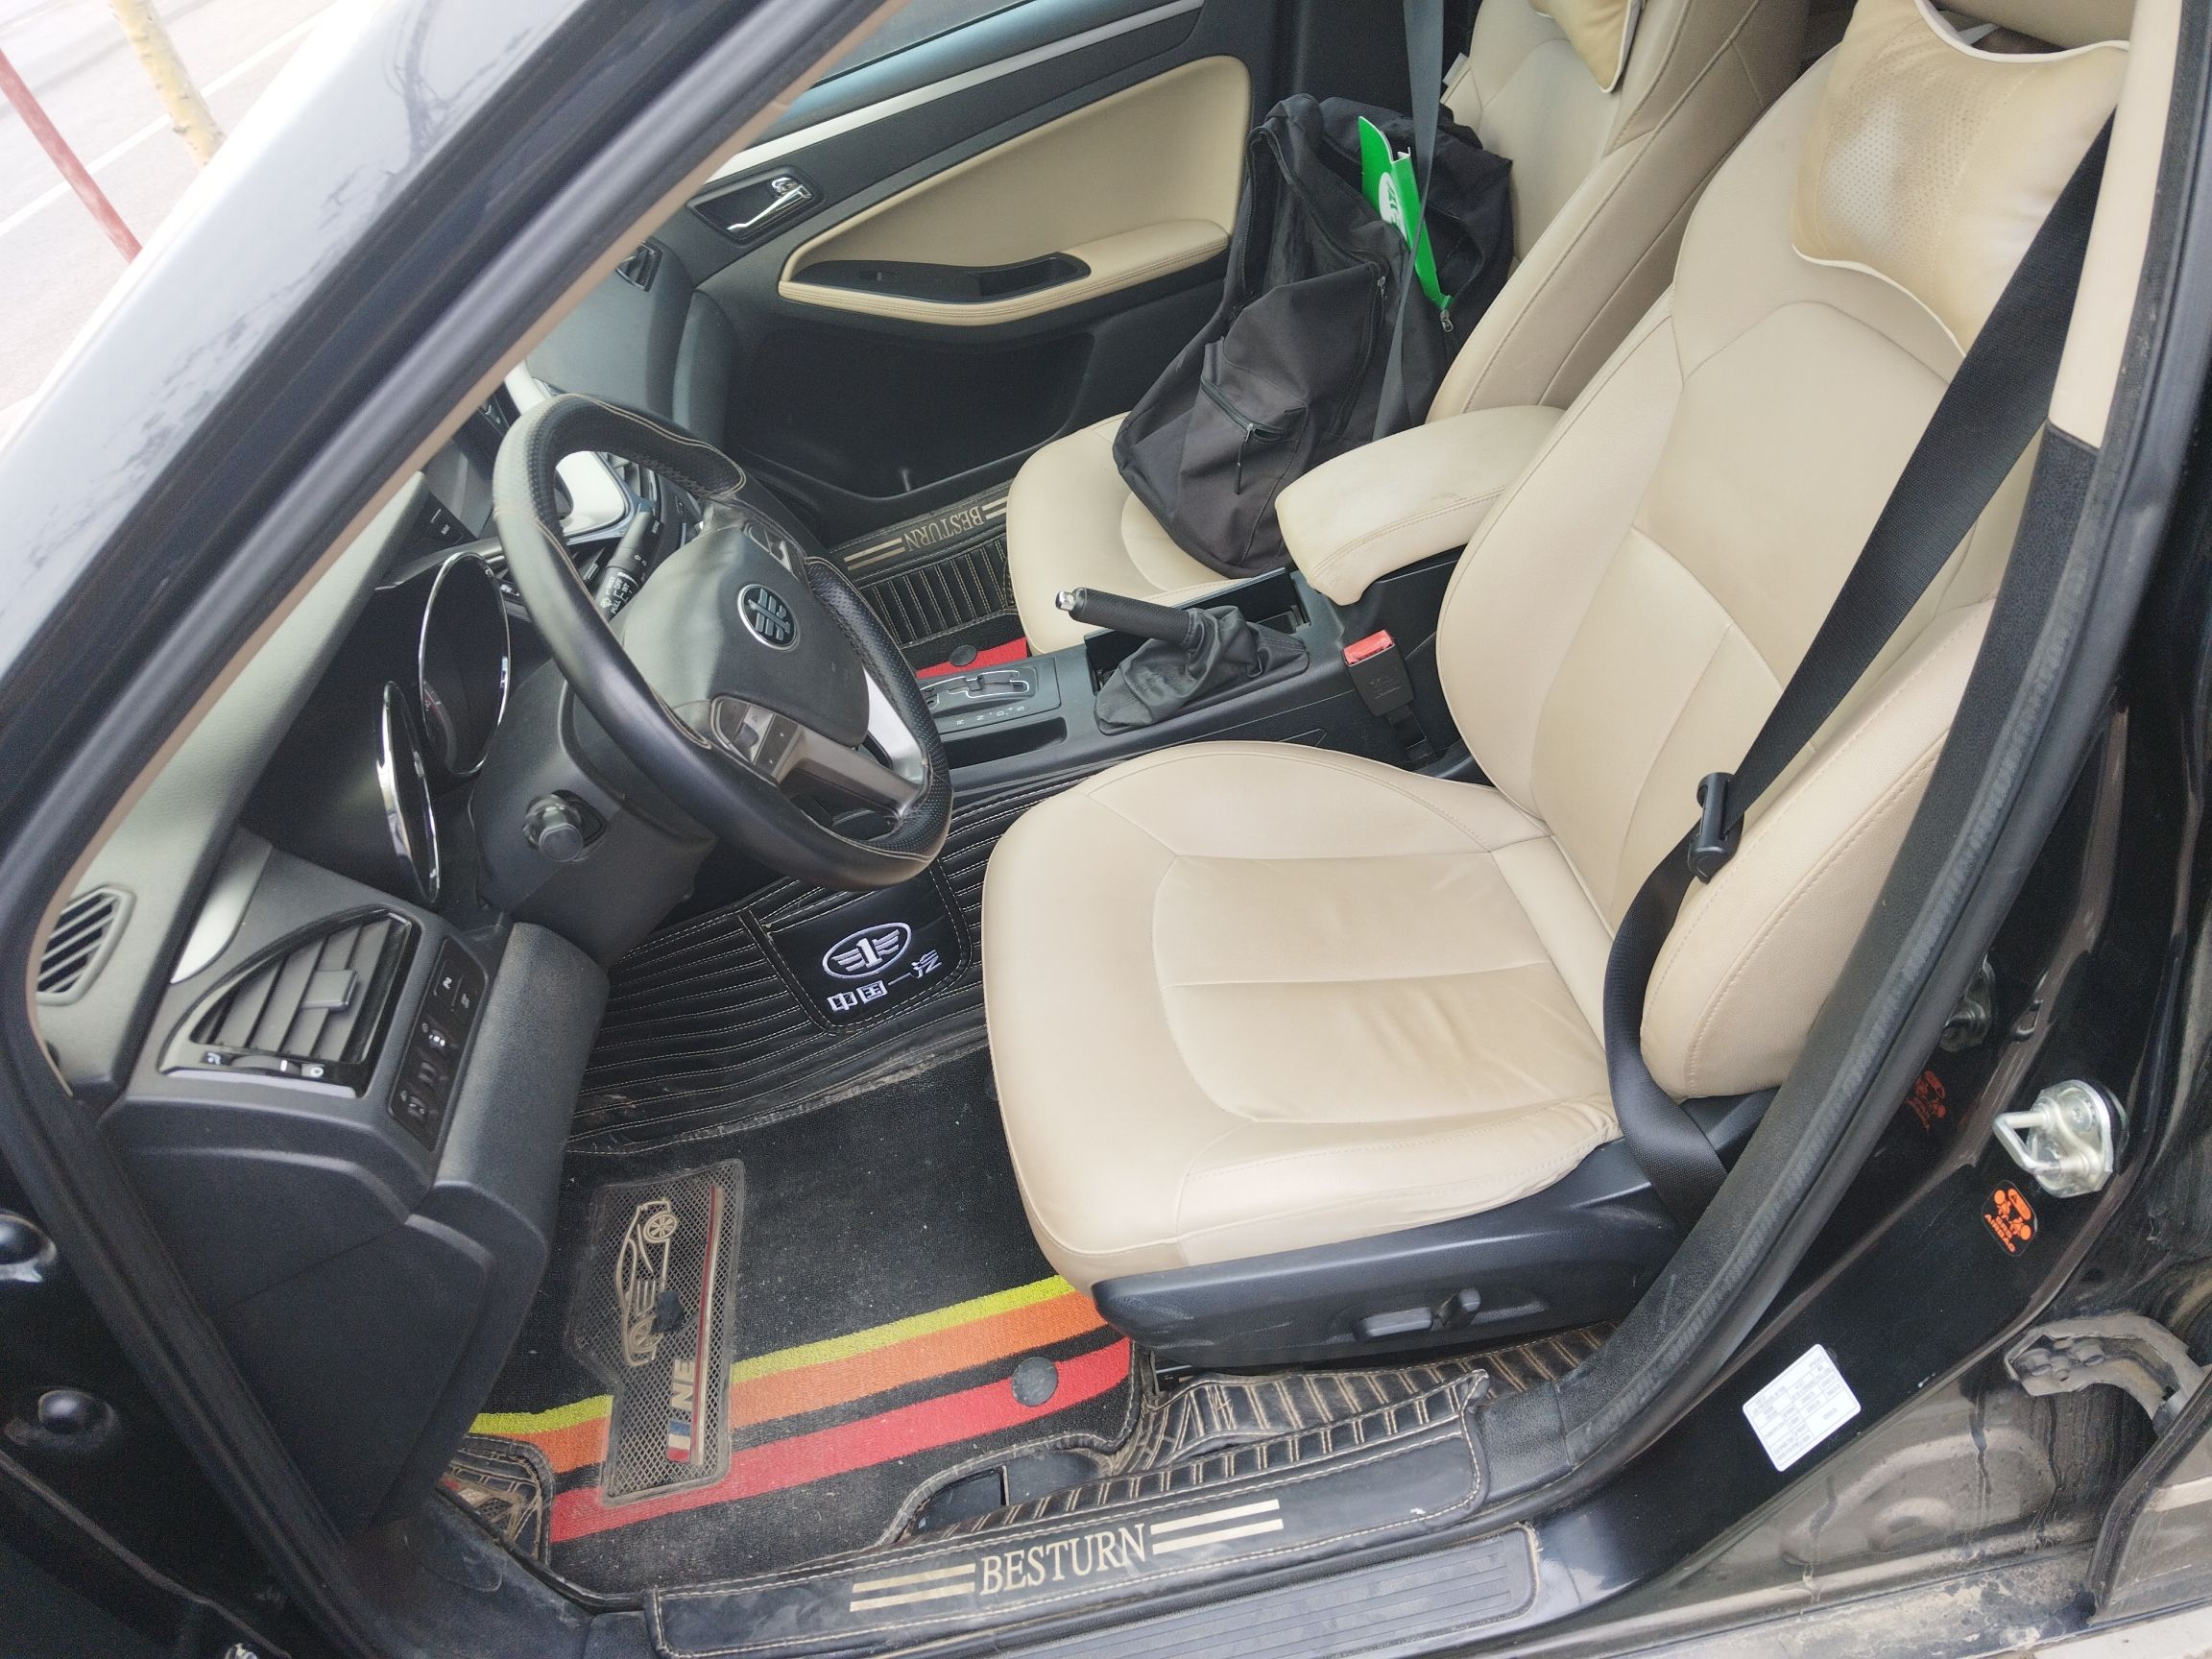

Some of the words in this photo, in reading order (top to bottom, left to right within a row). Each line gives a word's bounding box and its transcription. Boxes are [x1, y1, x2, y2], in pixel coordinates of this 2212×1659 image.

[904, 505, 985, 553] BESTURN
[613, 577, 623, 589] OFF
[611, 599, 622, 614] PULL
[826, 949, 943, 1013] 中国一汽
[1984, 1214, 2016, 1253] AIRBAG
[979, 1523, 1147, 1597] BESTURN
